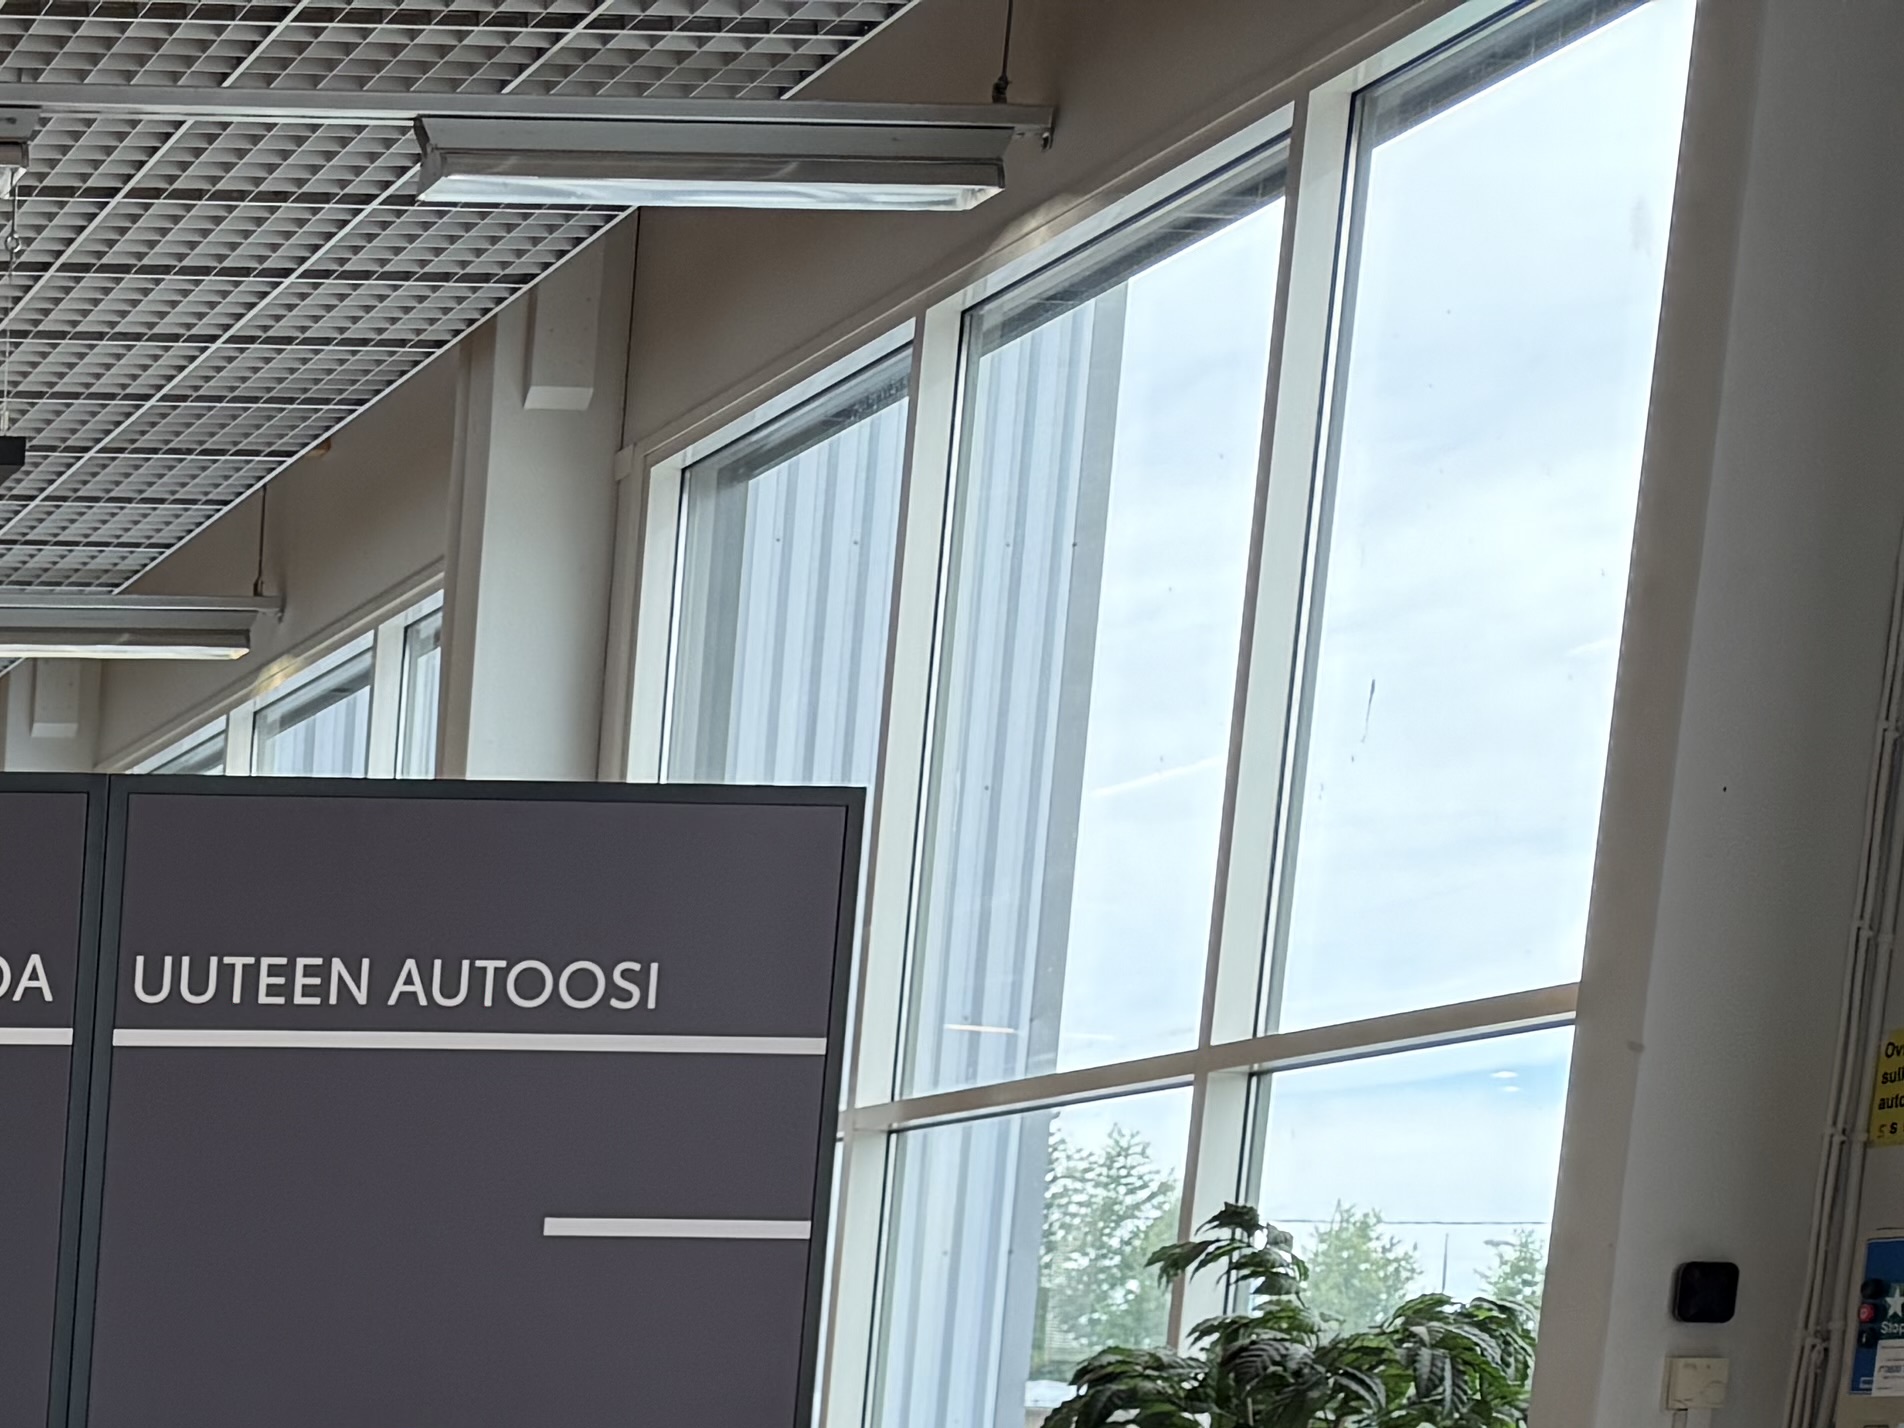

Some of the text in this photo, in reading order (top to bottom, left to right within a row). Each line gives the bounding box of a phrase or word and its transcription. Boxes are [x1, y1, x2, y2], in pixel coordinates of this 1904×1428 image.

[134, 955, 370, 1006] UUTEEN
[387, 958, 659, 1010] AUTOOSI
[1885, 1041, 1904, 1058] Ov
